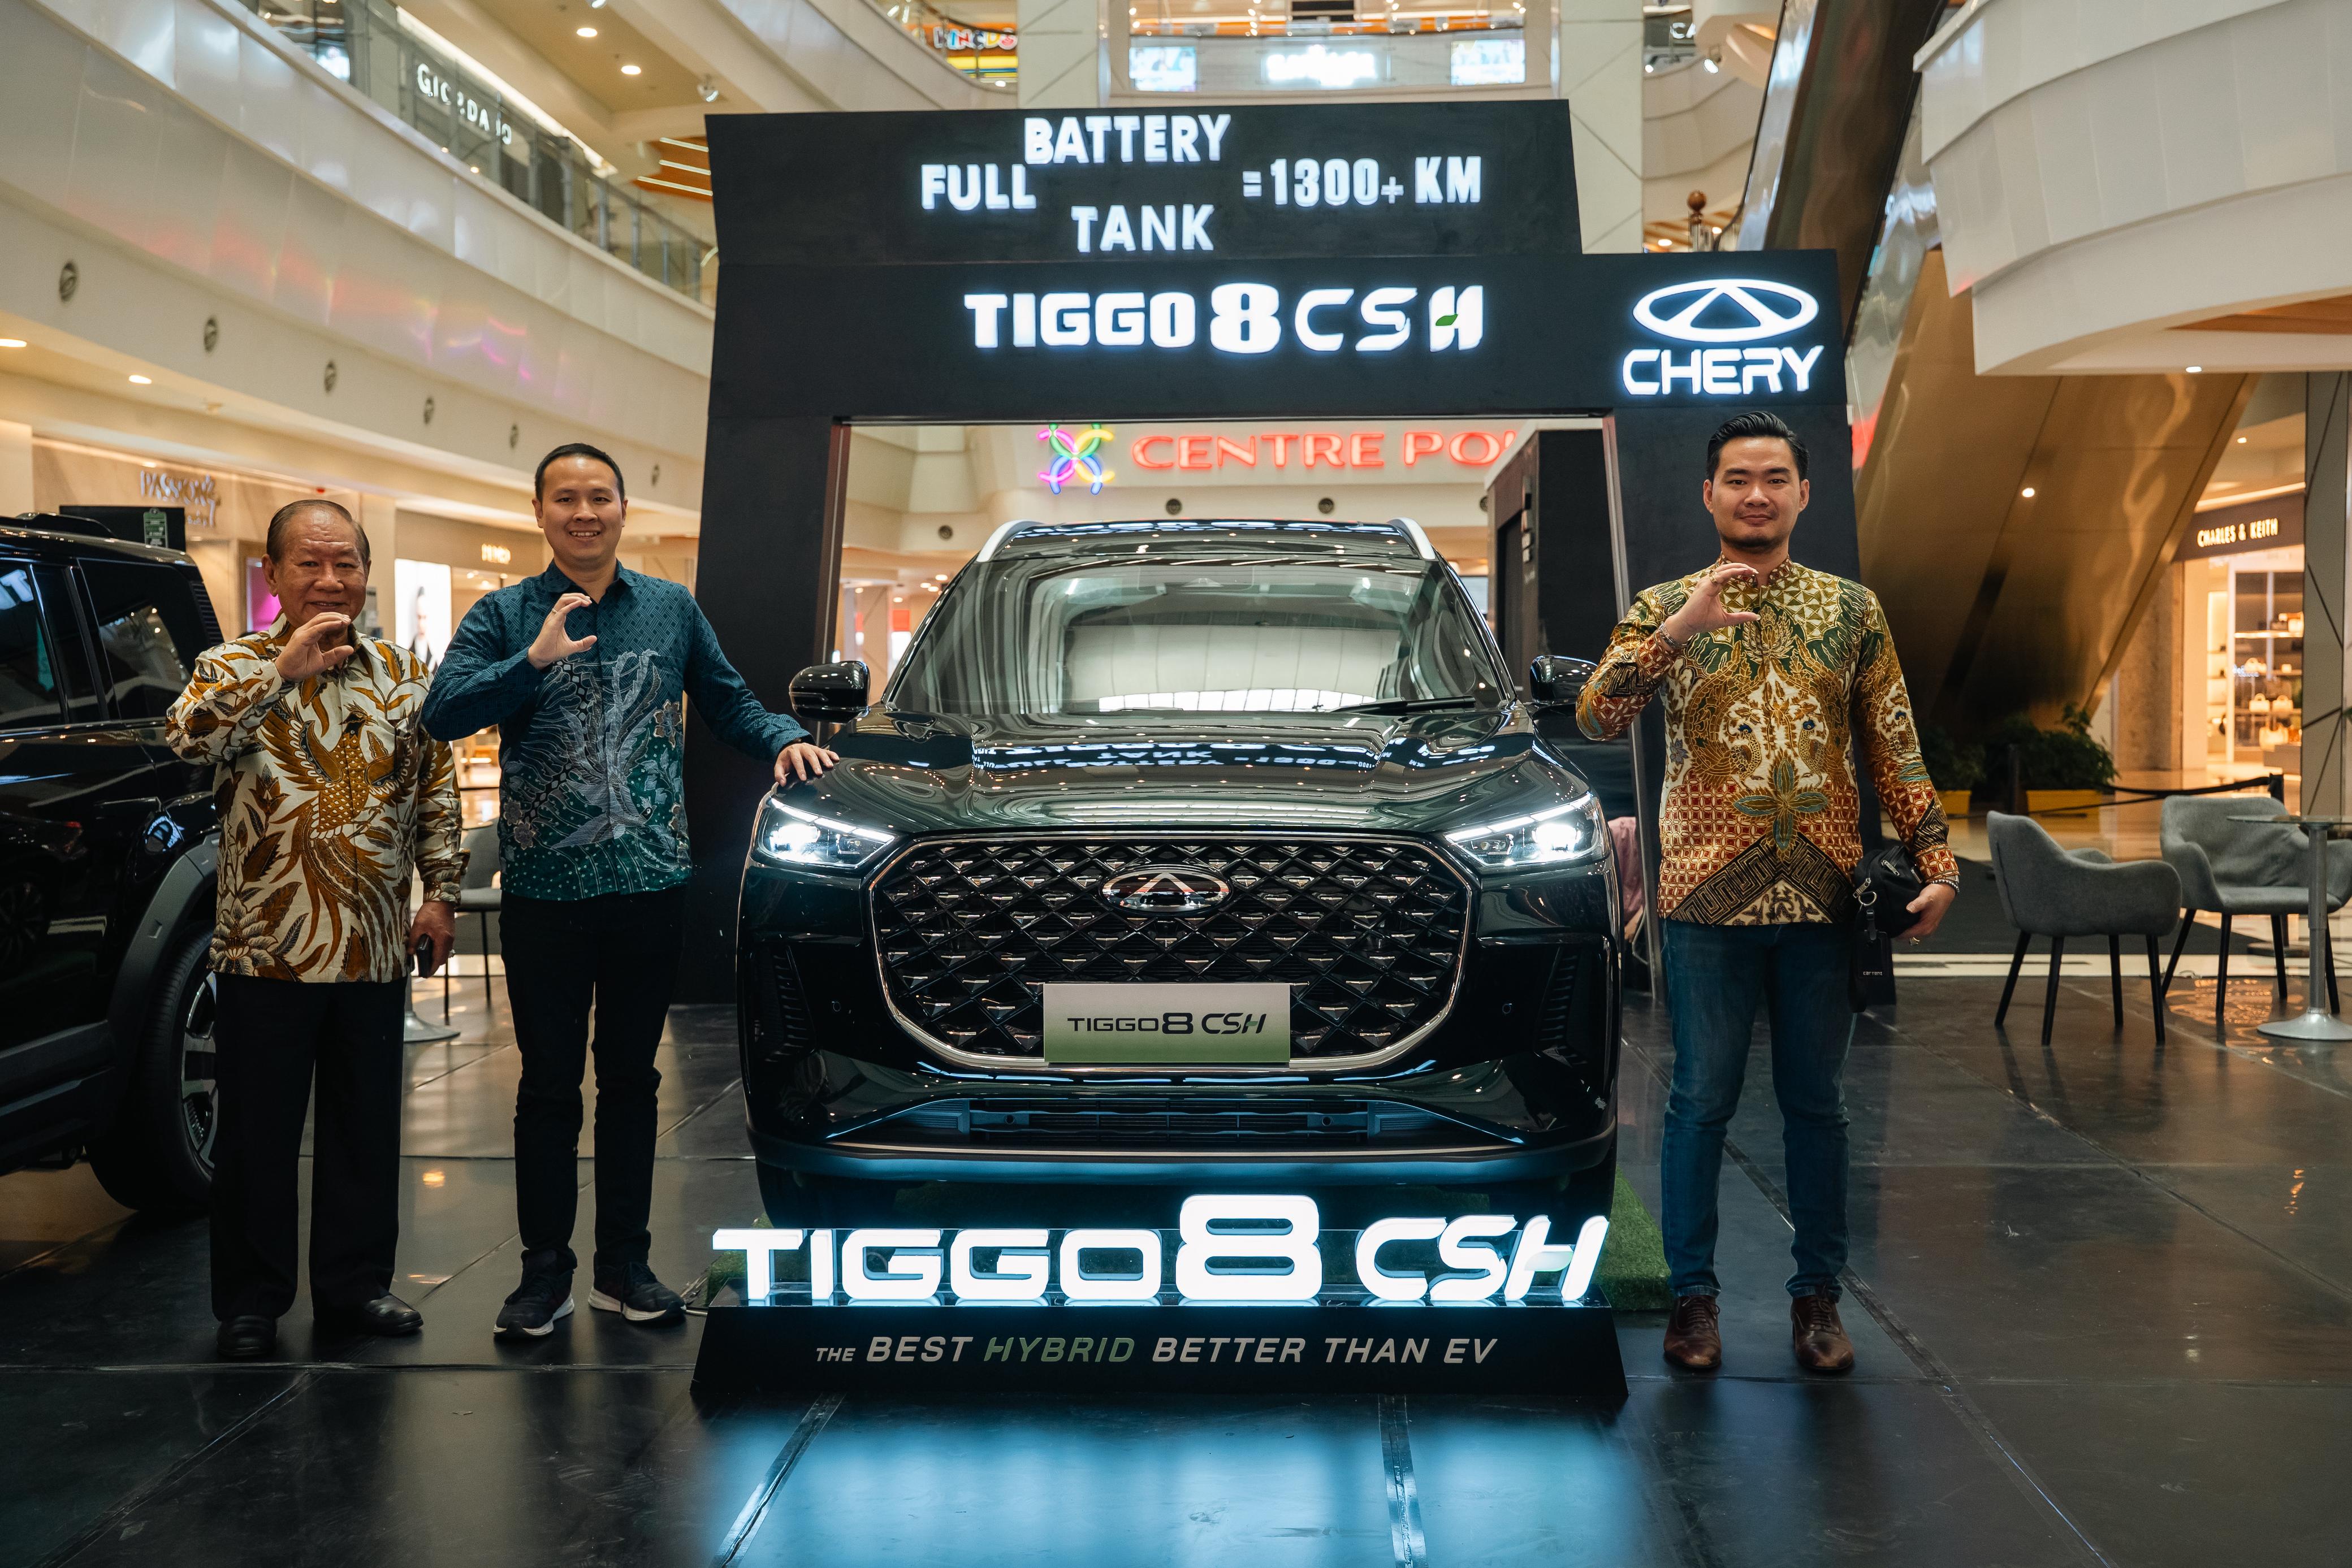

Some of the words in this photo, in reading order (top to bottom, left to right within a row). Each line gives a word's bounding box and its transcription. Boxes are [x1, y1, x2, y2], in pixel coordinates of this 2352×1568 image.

[417, 63, 512, 145] GIODAO
[1024, 114, 1231, 165] BATTERY
[920, 163, 1037, 211] FULL
[1415, 155, 1481, 204] KM
[1070, 204, 1215, 253] TANK
[1294, 285, 1484, 353] CSH
[1622, 345, 1824, 396] CHERY
[1130, 432, 1385, 471] CENTRE
[2197, 525, 2236, 547] CHARLES
[2238, 523, 2247, 541] &
[2250, 518, 2278, 539] KEITH
[1201, 1012, 1268, 1034] CSH
[1356, 1215, 1609, 1301] CSH
[816, 1348, 856, 1362] THE
[866, 1336, 974, 1362] BEST
[984, 1337, 1135, 1362] HYBRID
[1152, 1337, 1306, 1363] BETTER
[1325, 1338, 1430, 1363] THAN
[1443, 1338, 1498, 1363] EV
